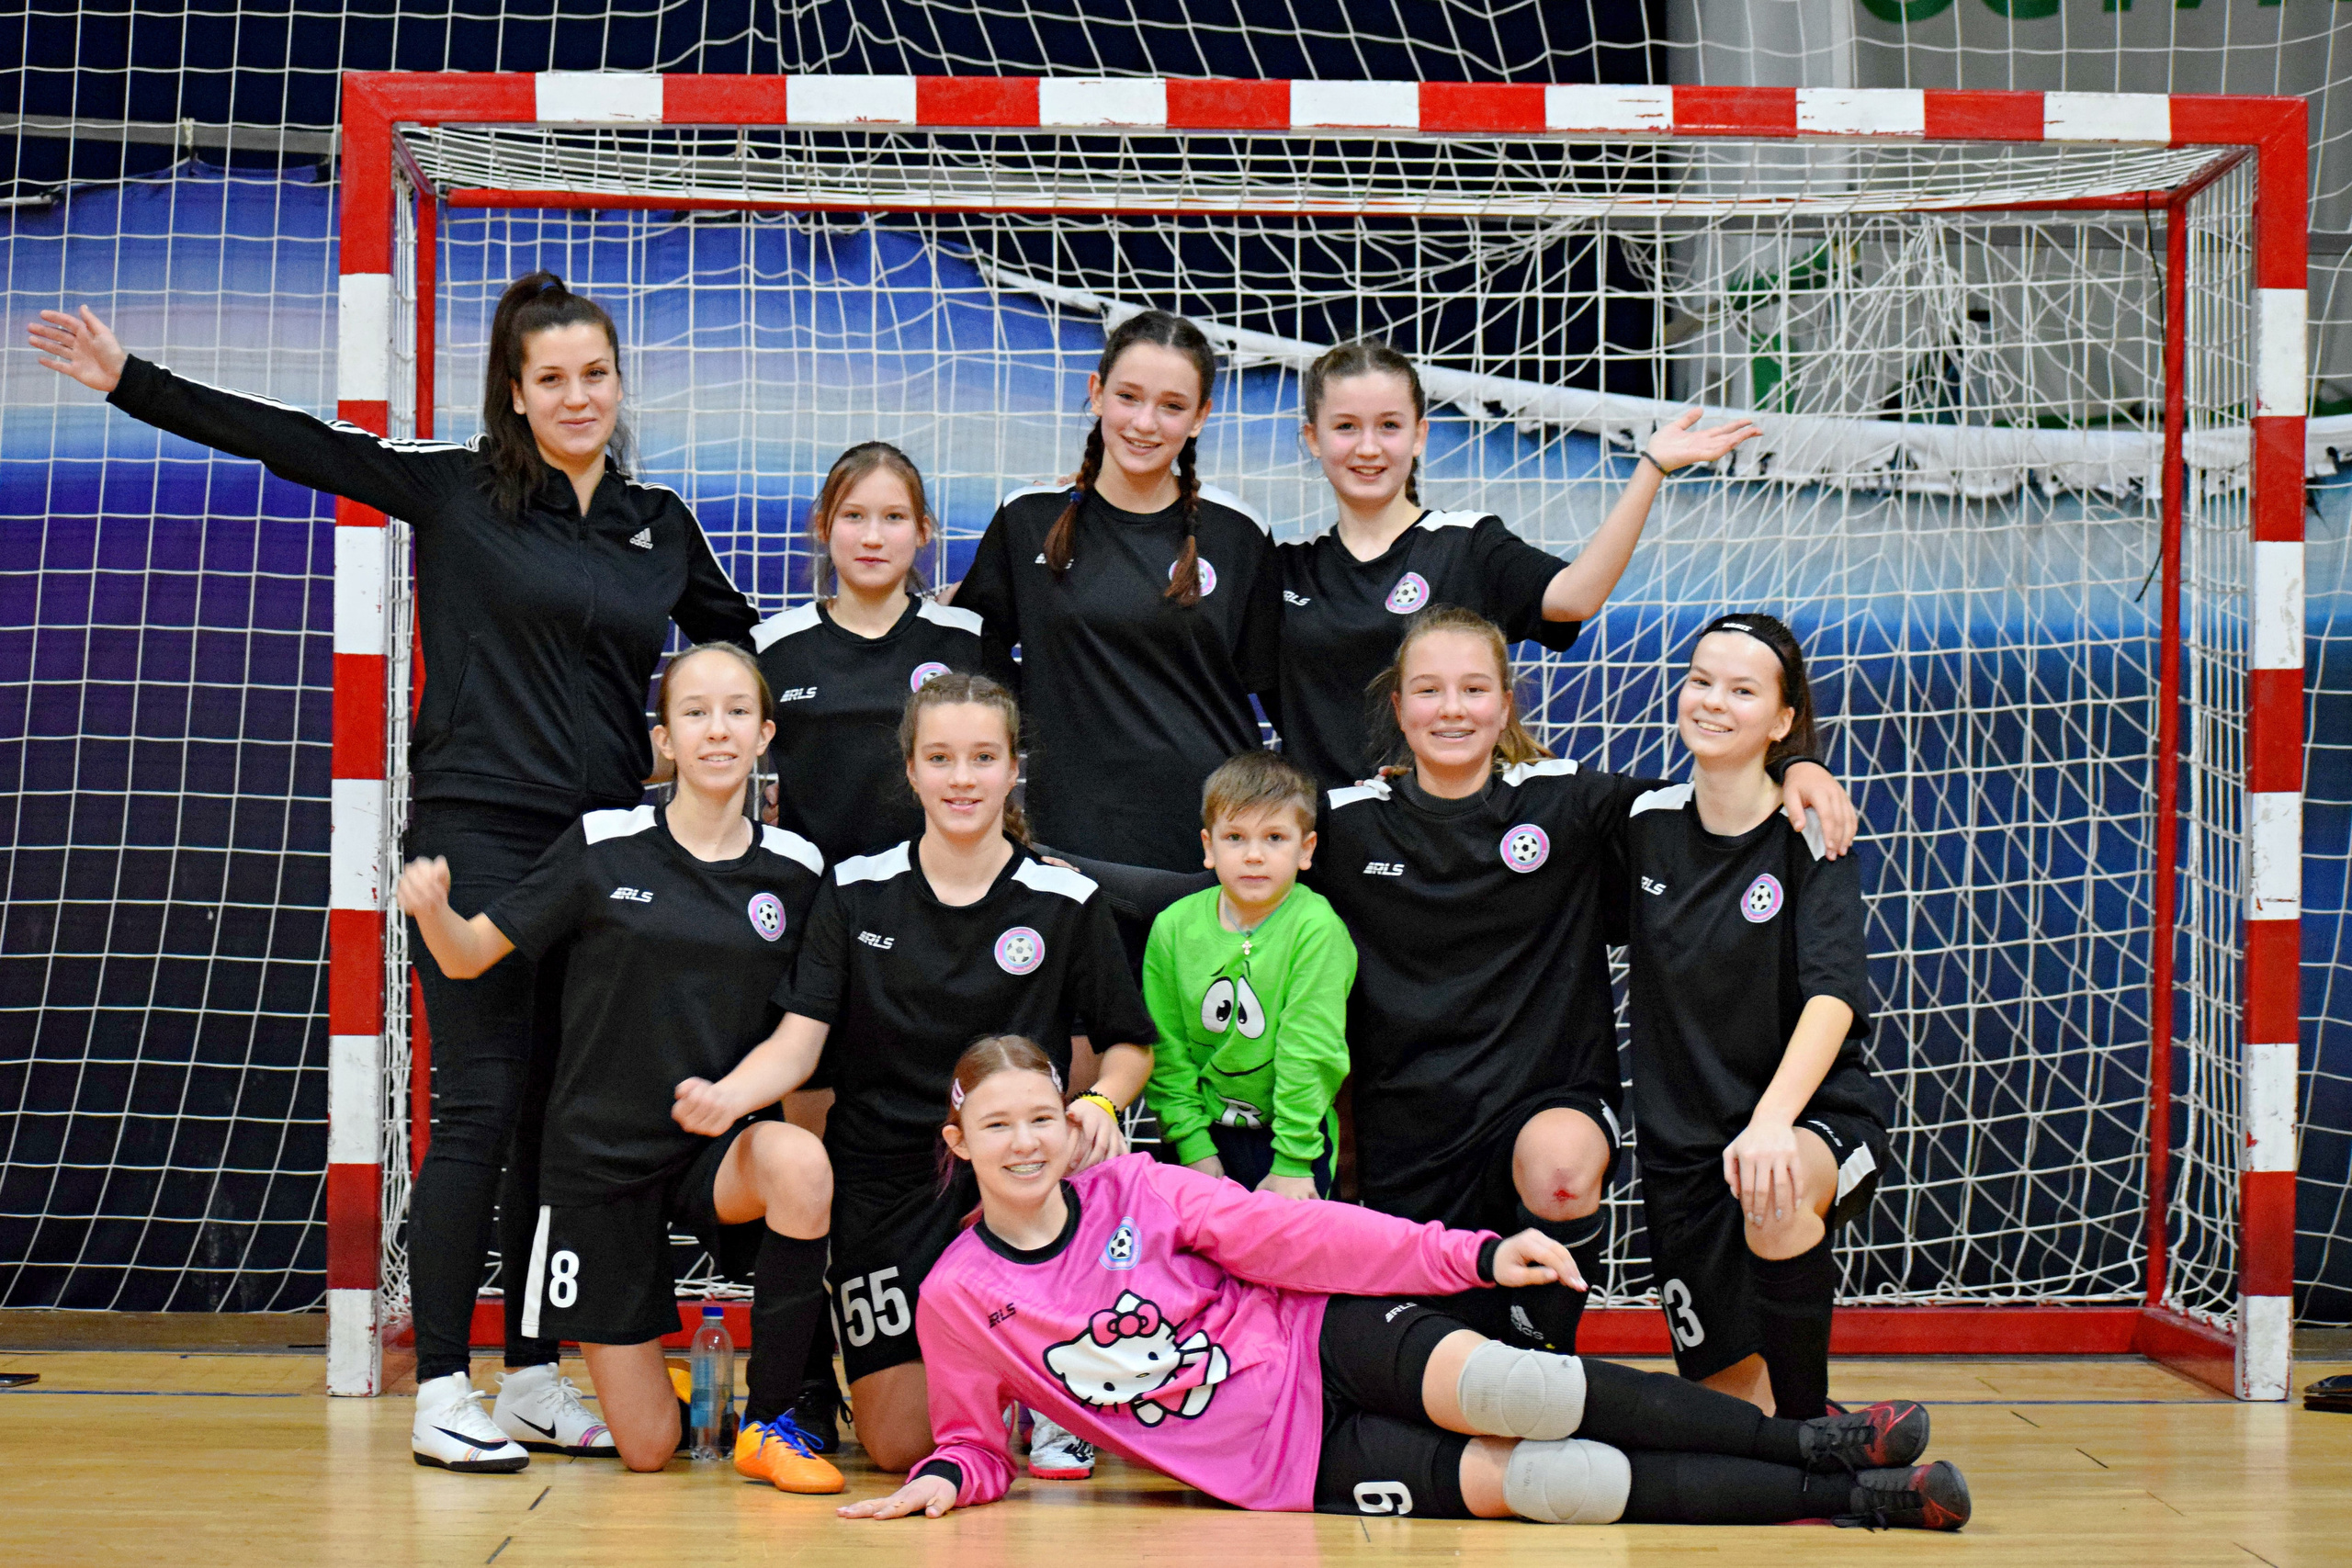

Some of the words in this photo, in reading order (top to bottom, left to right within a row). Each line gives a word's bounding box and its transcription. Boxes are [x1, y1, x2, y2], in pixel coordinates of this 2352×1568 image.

[629, 537, 654, 550] adidas
[548, 1249, 580, 1309] 8
[840, 1265, 912, 1348] 55
